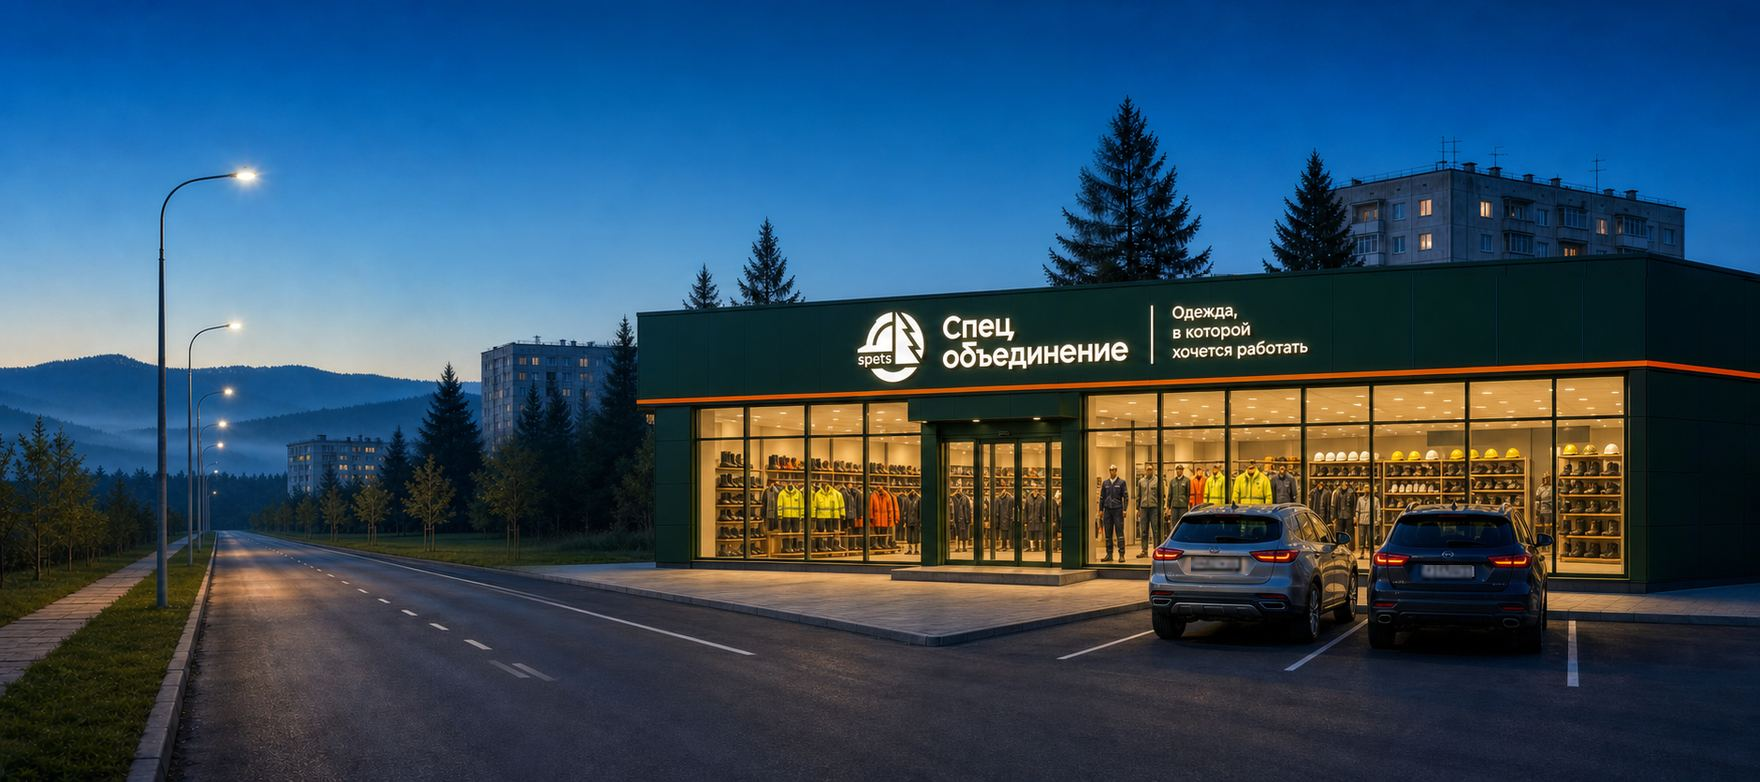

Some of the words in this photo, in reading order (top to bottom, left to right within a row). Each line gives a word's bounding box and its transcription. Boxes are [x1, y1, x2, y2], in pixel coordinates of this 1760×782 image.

[1172, 305, 1238, 321] Одежда,
[942, 315, 1014, 341] Спец
[1172, 328, 1181, 339] в
[1185, 322, 1251, 340] которой
[942, 339, 1129, 369] объединение
[1172, 346, 1233, 359] хочется
[1237, 340, 1309, 359] работать
[857, 353, 892, 368] spets
